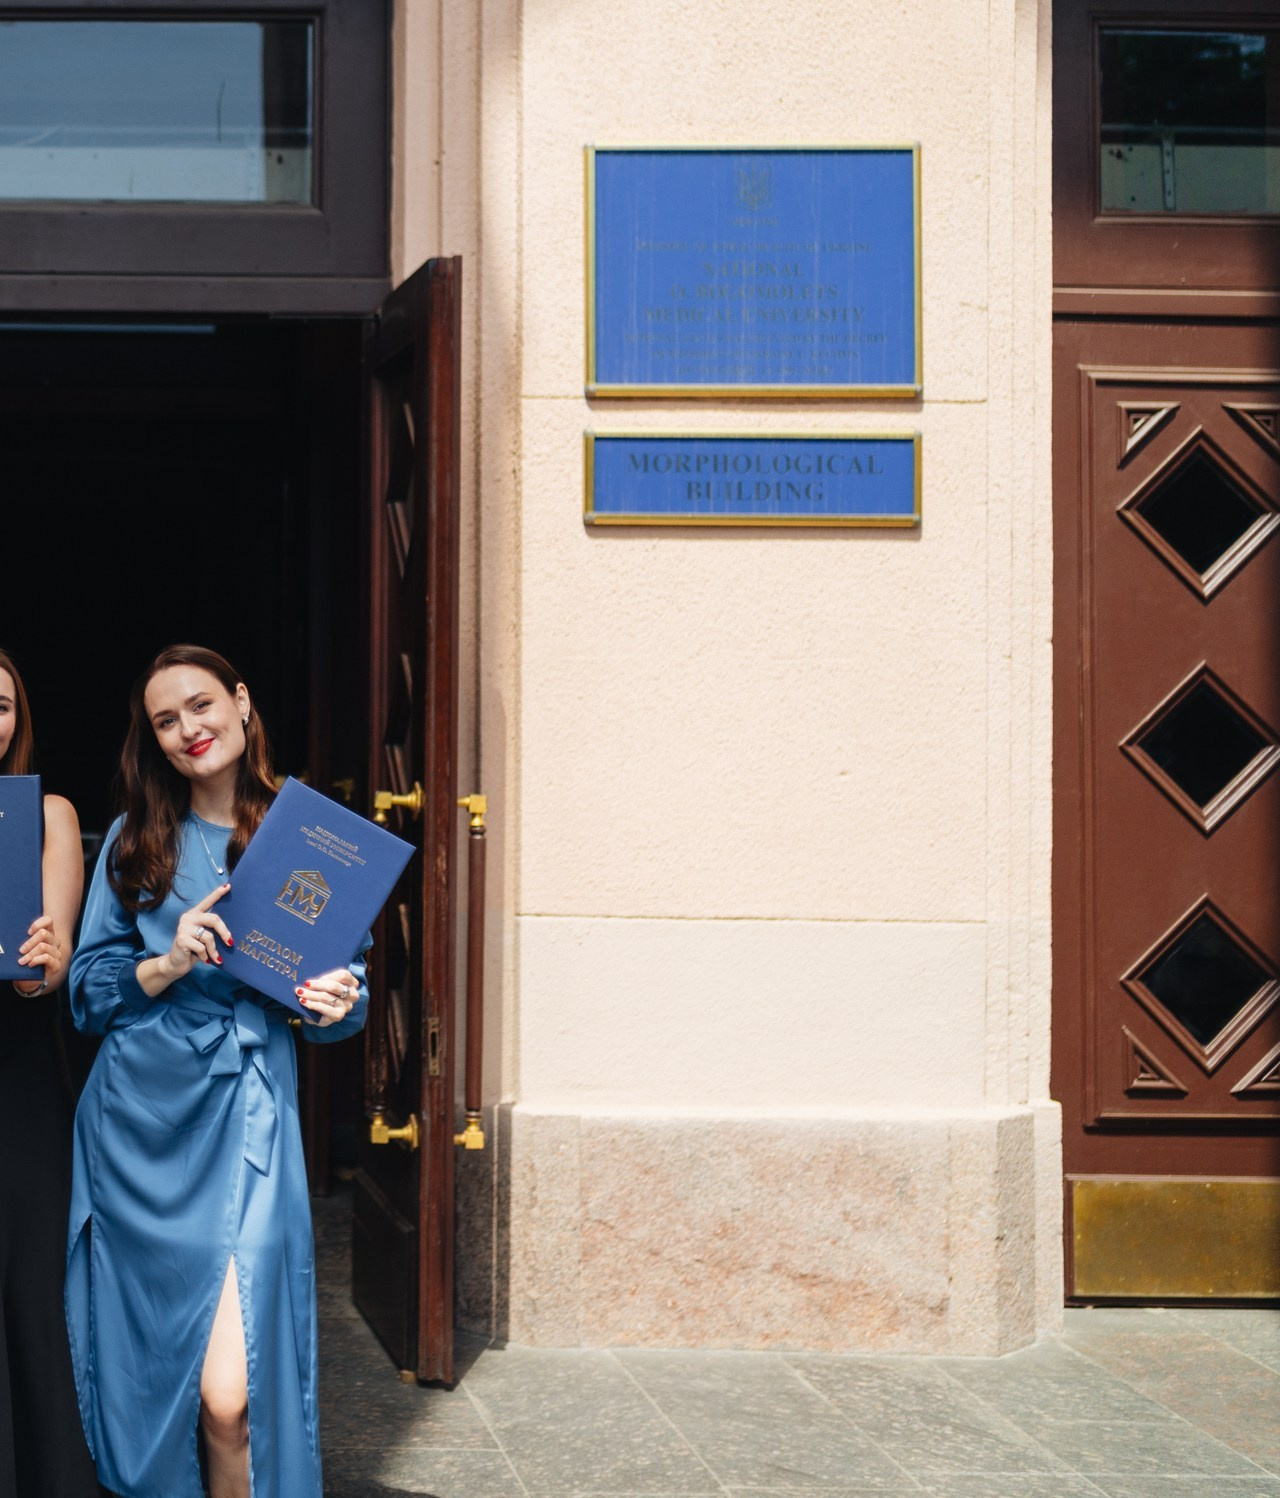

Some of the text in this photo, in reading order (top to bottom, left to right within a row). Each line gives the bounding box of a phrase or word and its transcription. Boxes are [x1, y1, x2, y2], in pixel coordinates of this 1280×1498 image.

[703, 262, 806, 278] NATIONAL
[696, 284, 839, 300] BOGOMOLETS
[644, 306, 864, 322] MEDICAL UNIVERSITY
[628, 453, 884, 475] MORPHOLOGICAL
[686, 480, 824, 502] BUILDING
[246, 929, 303, 966] ДИПЛОМ
[237, 941, 298, 982] МАГІСТРА
